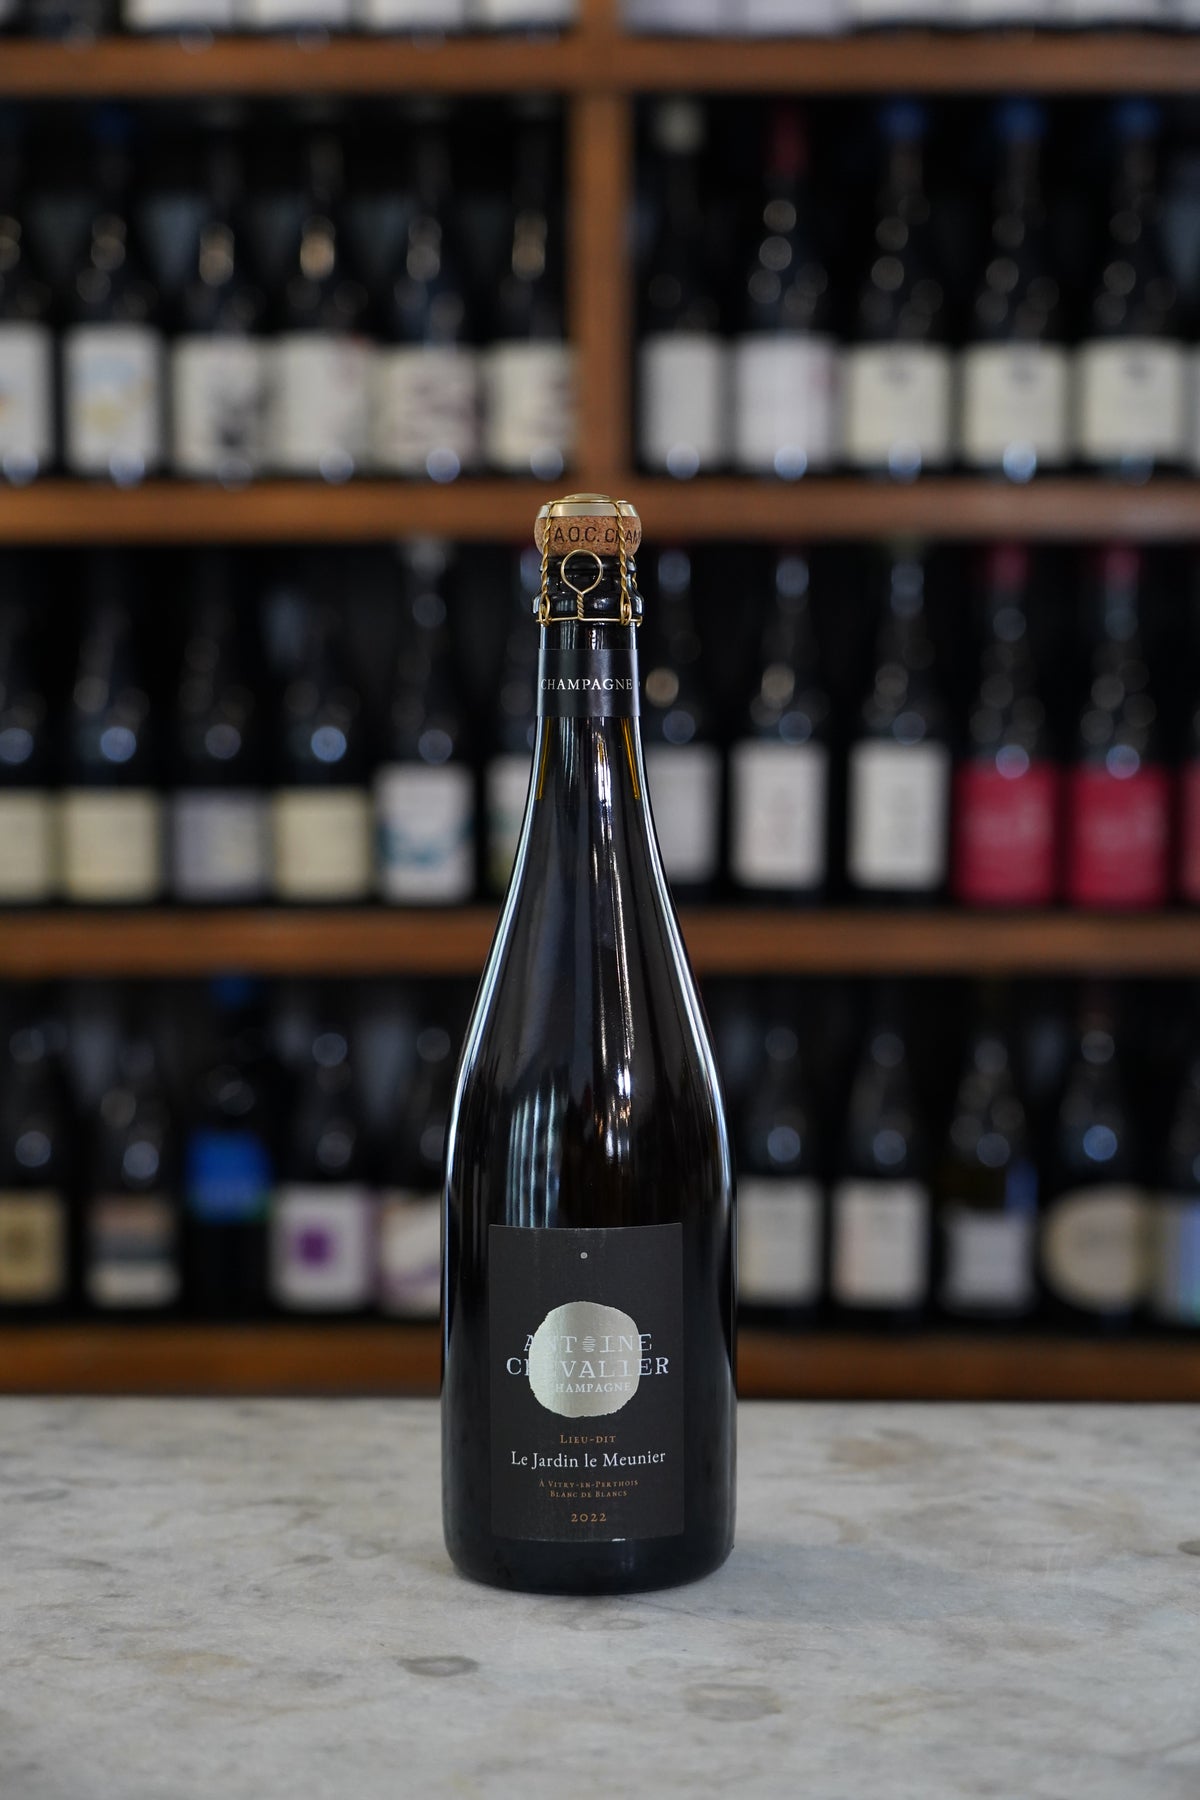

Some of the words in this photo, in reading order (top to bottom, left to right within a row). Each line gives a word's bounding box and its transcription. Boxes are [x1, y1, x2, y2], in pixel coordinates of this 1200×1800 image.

[554, 526, 600, 543] A.O.C.
[540, 678, 633, 690] CHAMPAGNE
[523, 1334, 652, 1353] ATOINE
[506, 1357, 670, 1378] CVALIER
[549, 1382, 632, 1393] HAMPAGNE
[511, 1450, 529, 1466] Le
[531, 1452, 579, 1470] Jardin
[584, 1452, 598, 1468] le
[602, 1450, 666, 1467] Meunier
[571, 1513, 607, 1523] 2022
